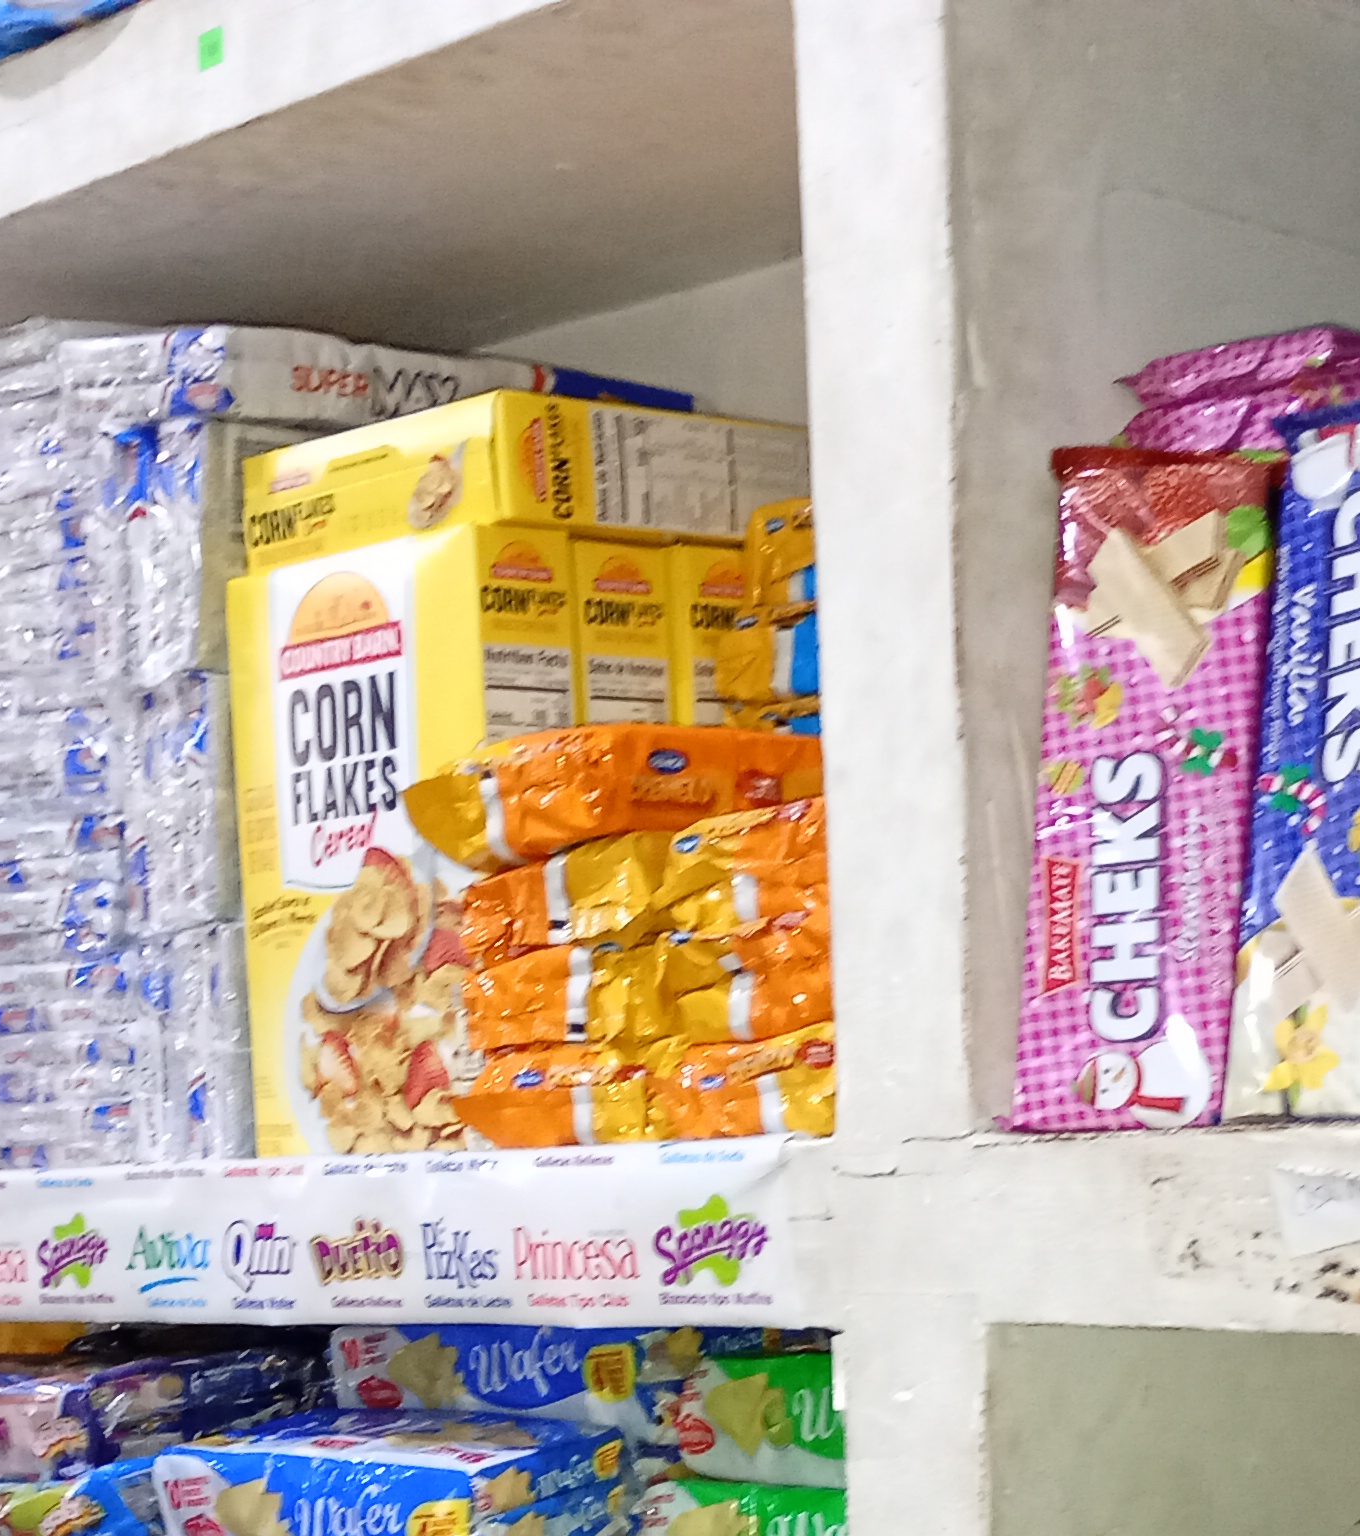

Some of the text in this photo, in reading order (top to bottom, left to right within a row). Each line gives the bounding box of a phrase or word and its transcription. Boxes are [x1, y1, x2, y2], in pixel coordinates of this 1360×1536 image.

[290, 671, 398, 766] CORN
[291, 756, 398, 827] FLAKES
[1090, 750, 1166, 1043] CHEKS
[126, 1226, 211, 1270] Aviva
[513, 1226, 641, 1281] Princesa
[468, 1326, 582, 1396] Wafer
